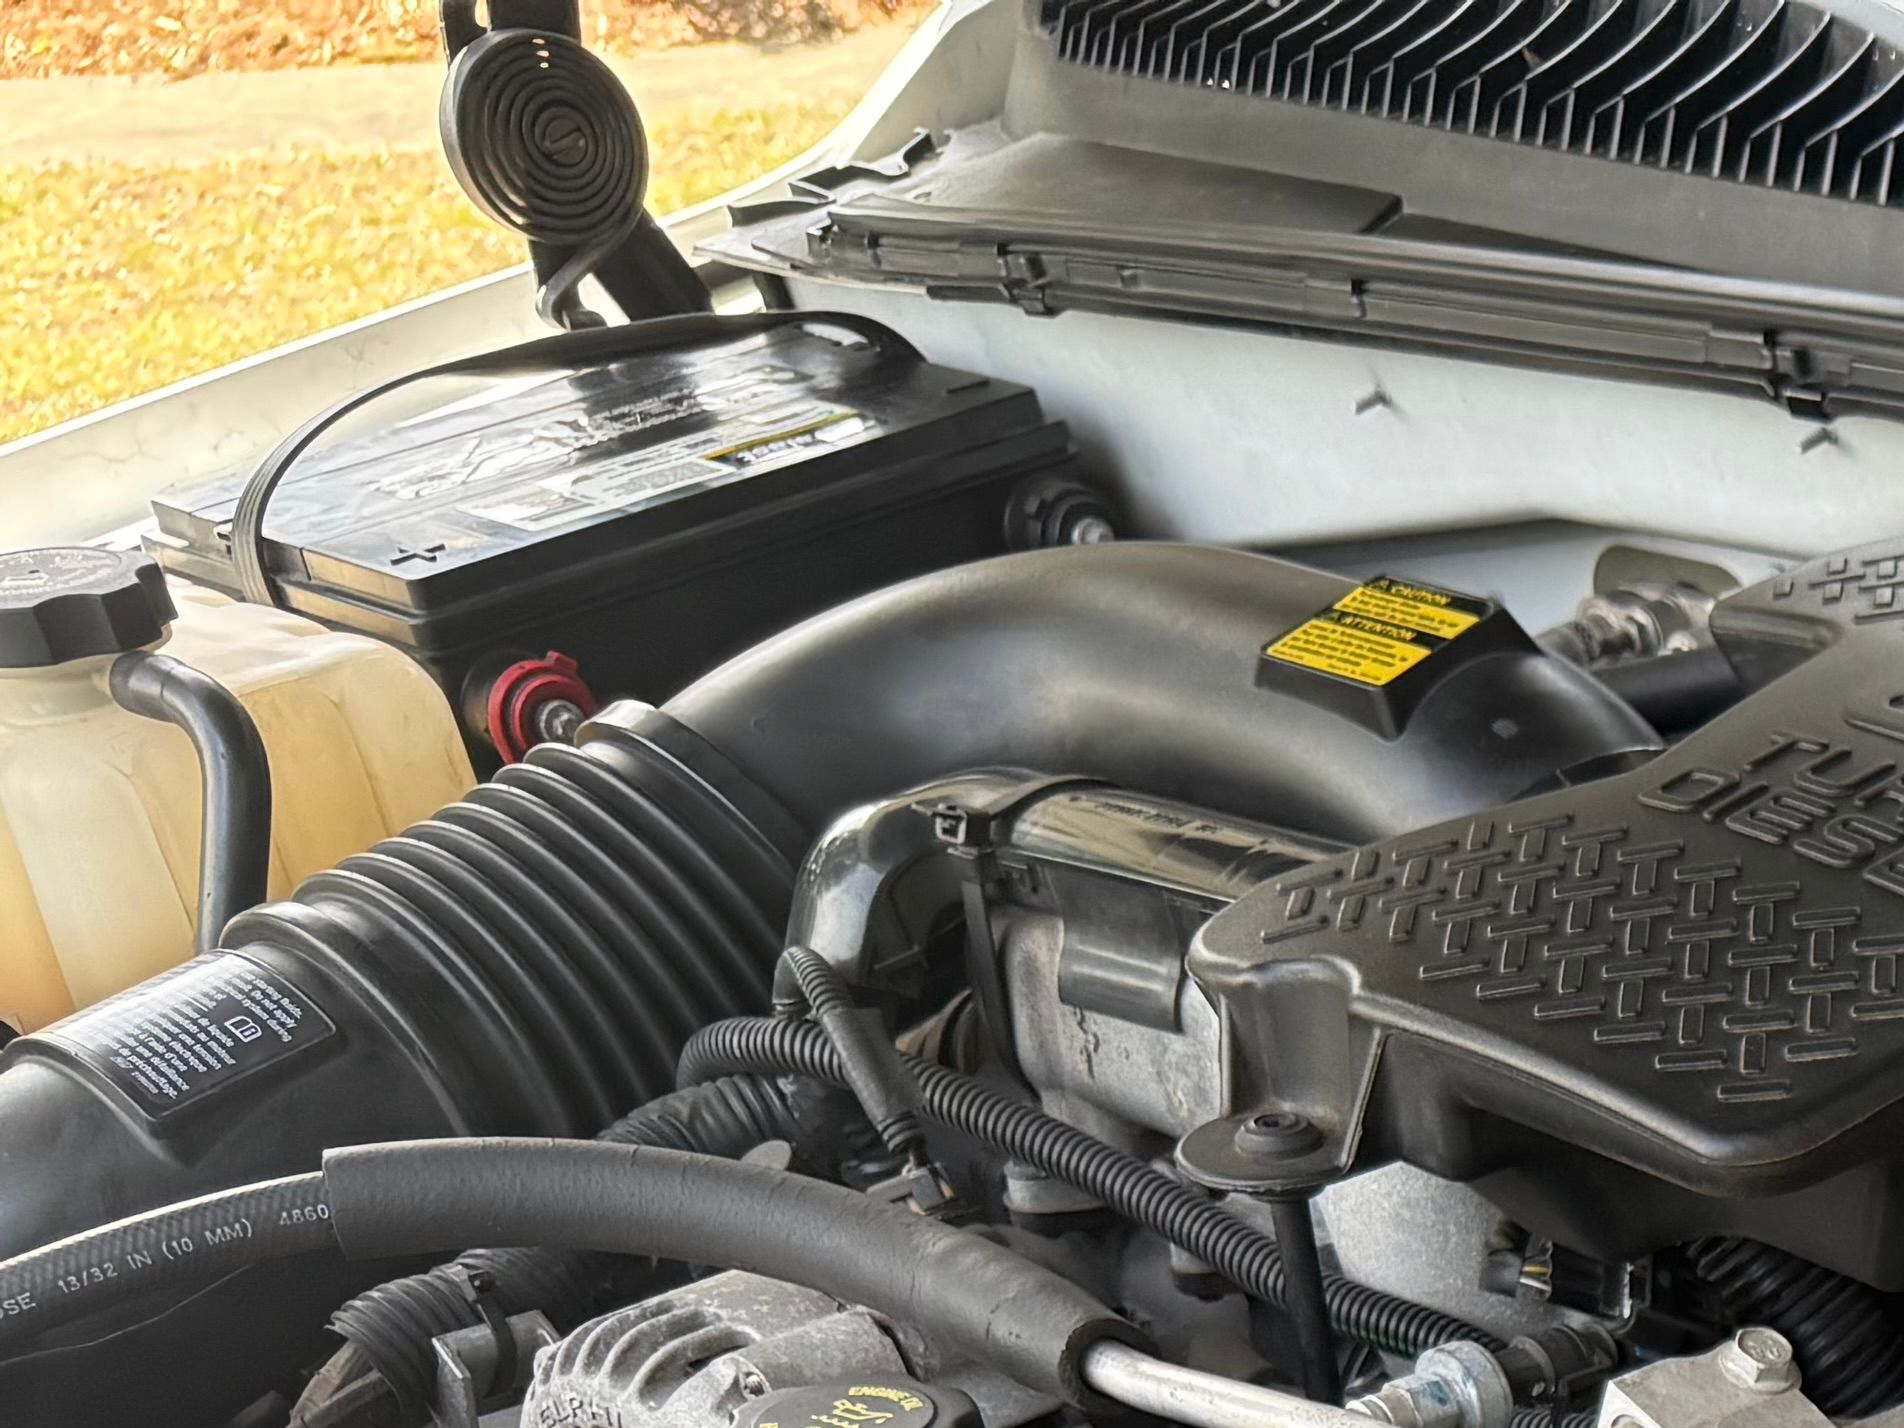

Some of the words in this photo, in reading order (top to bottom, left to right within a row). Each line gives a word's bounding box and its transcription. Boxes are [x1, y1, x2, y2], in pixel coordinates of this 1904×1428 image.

[58, 1263, 118, 1293] 13/32
[127, 1254, 152, 1271] IN
[161, 1237, 193, 1261] (10
[204, 1218, 252, 1246] MM)
[279, 1203, 329, 1226] 4860
